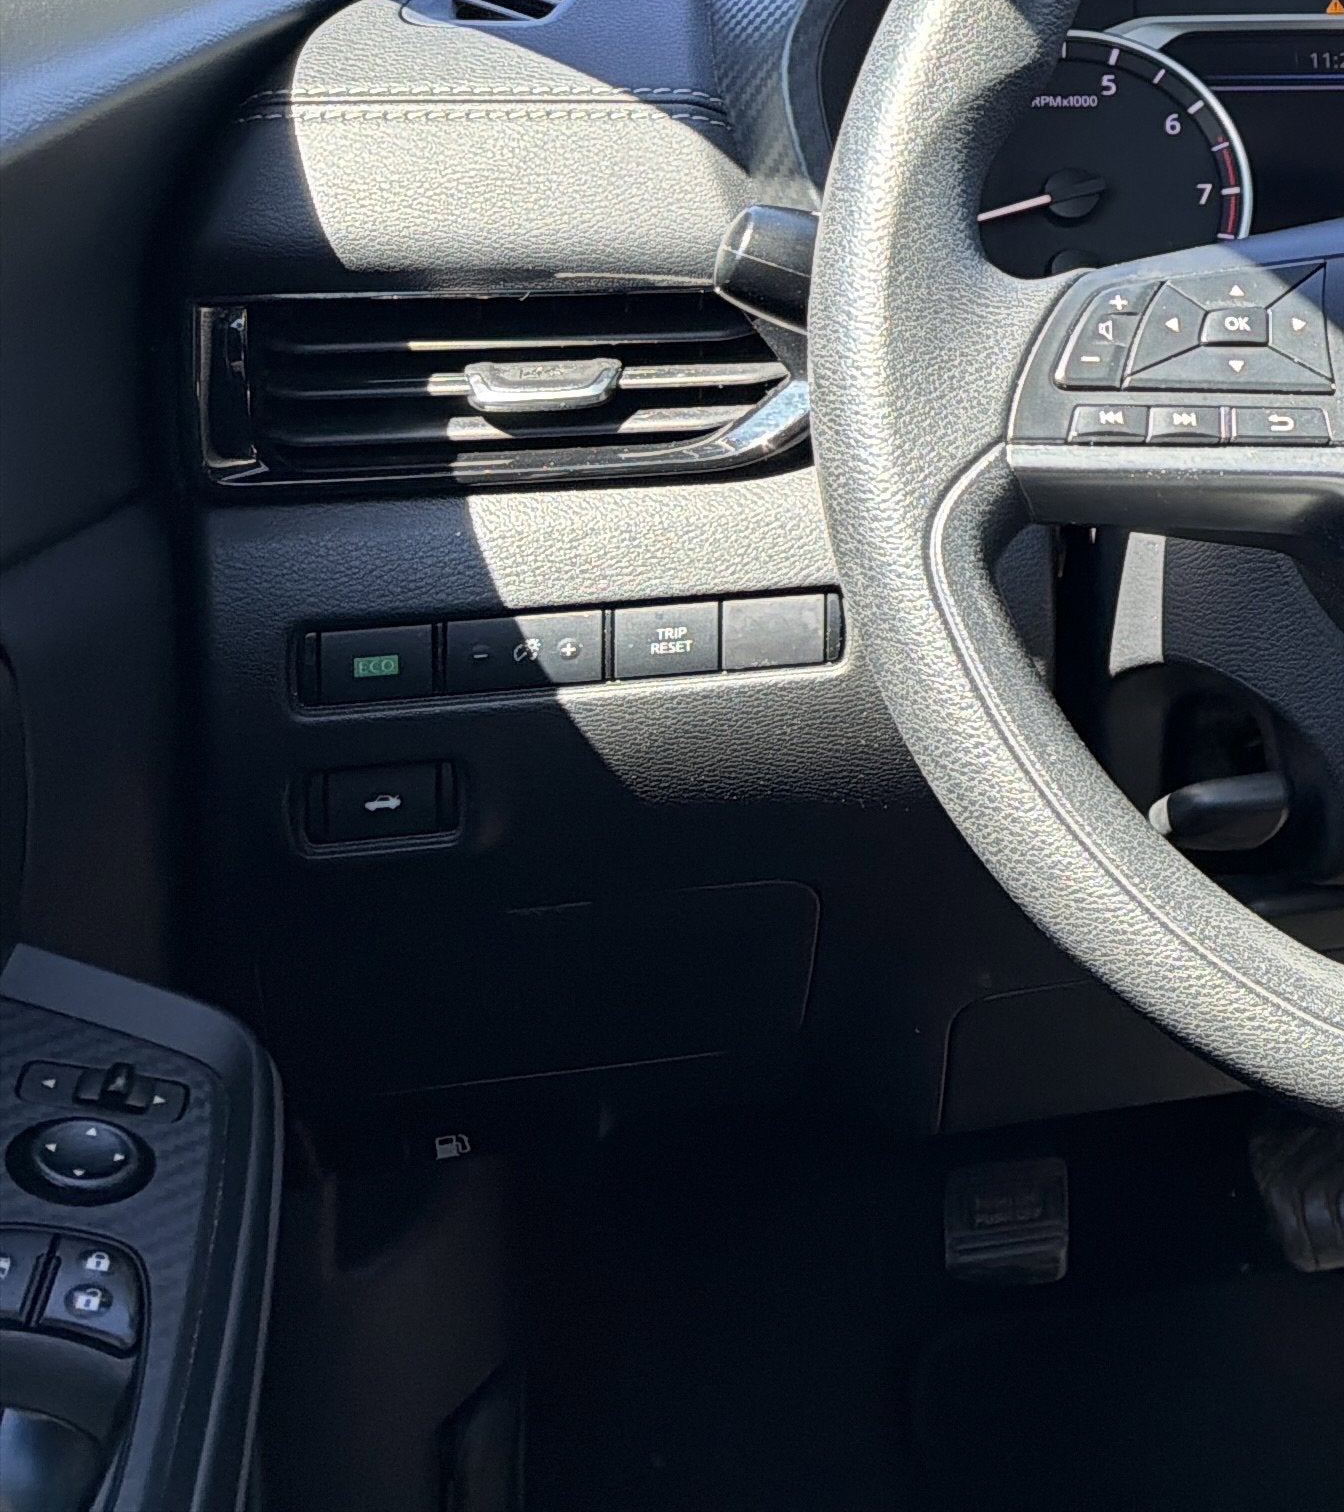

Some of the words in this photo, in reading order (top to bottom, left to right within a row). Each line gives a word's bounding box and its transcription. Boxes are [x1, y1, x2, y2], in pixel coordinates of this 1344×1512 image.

[1101, 74, 1117, 96] 5
[1165, 113, 1181, 135] 6
[1197, 183, 1213, 206] 7
[1224, 316, 1251, 333] OK
[656, 626, 688, 641] TRIP
[651, 639, 693, 655] RESET
[359, 659, 395, 674] ECO
